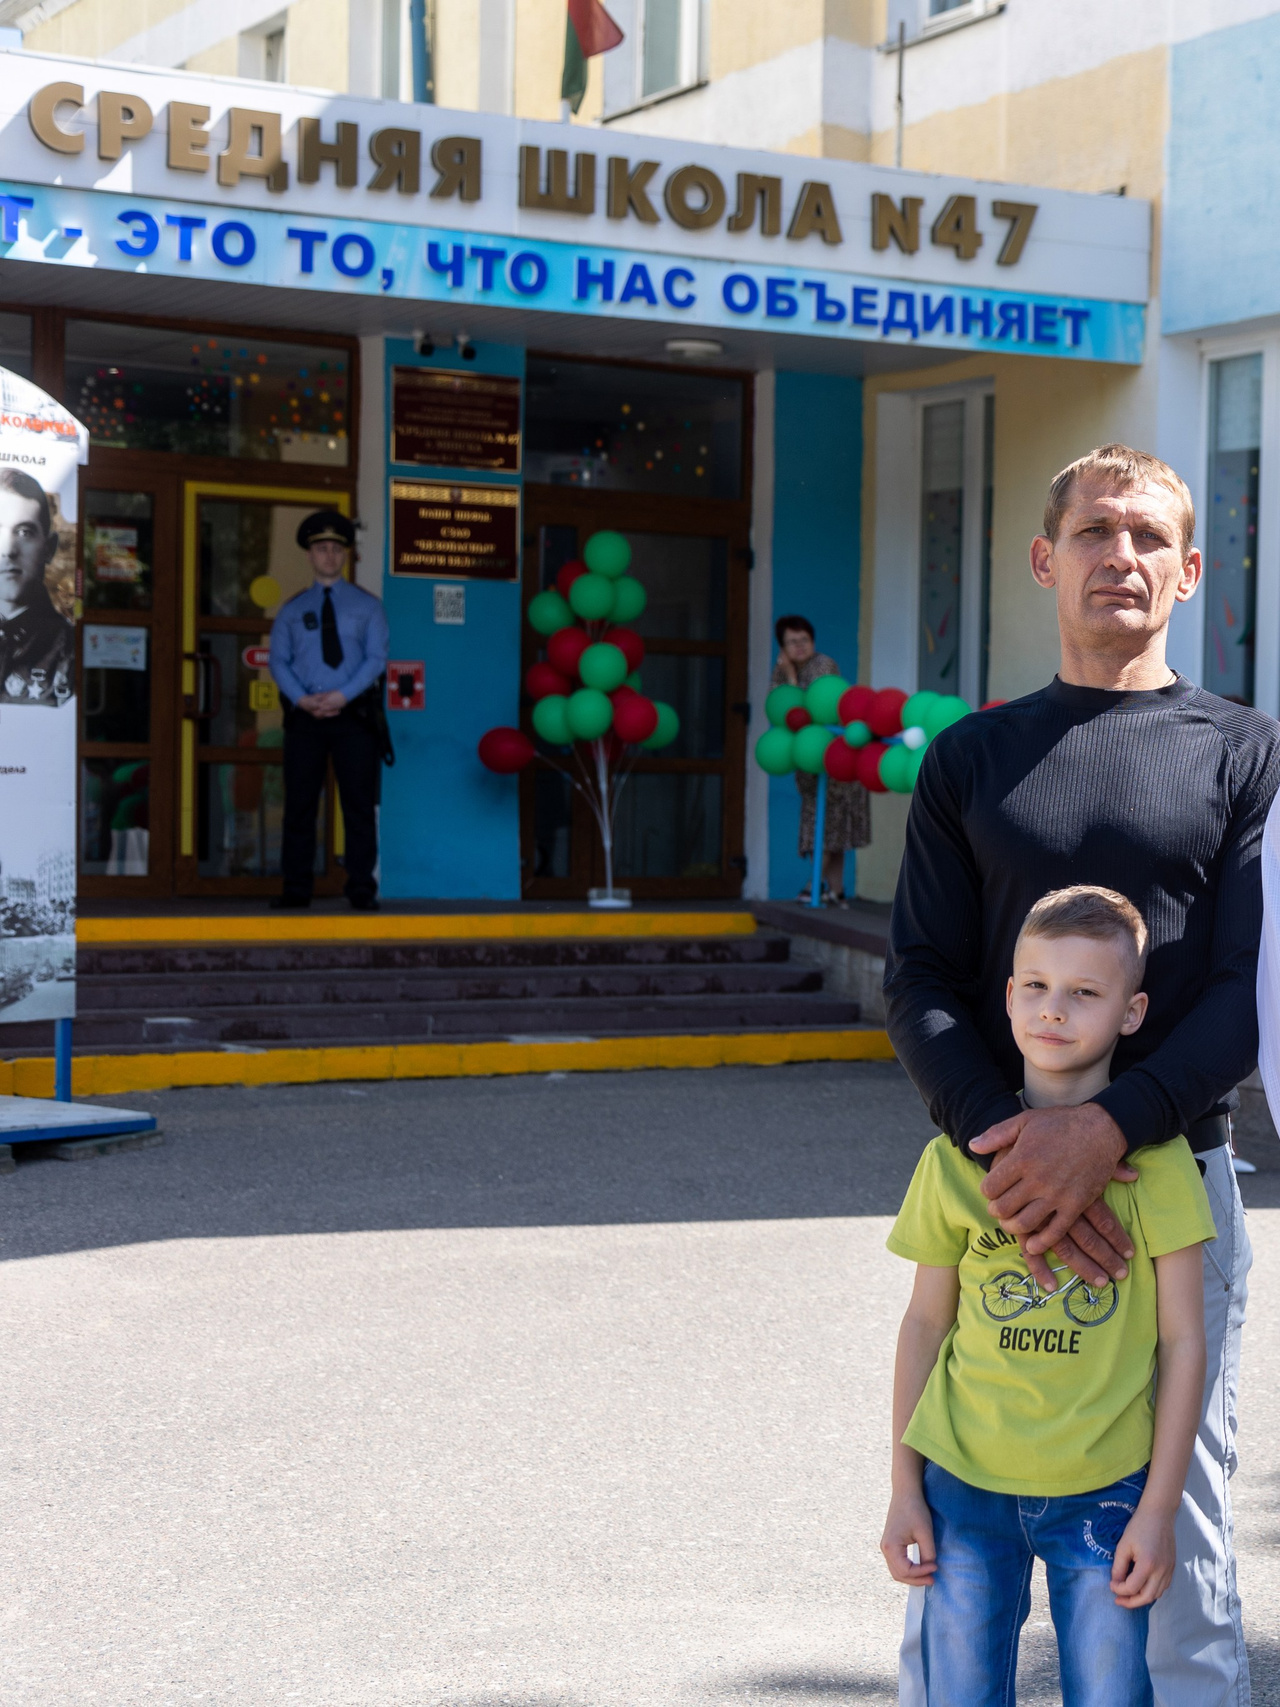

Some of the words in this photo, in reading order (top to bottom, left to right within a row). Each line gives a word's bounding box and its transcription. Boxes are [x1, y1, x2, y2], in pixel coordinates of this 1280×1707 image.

[29, 81, 482, 202] СРЕДНЯЯ
[519, 145, 842, 245] ШКОЛА
[116, 211, 256, 265] ЭТО
[287, 228, 395, 291] ТО,
[427, 242, 549, 294] ЧТО
[576, 257, 697, 309] НАС
[722, 274, 1091, 346] ОБЪЕДИНЯЕТ
[999, 1326, 1082, 1354] BICYCLE
[1083, 1519, 1114, 1560] FREESTYL
